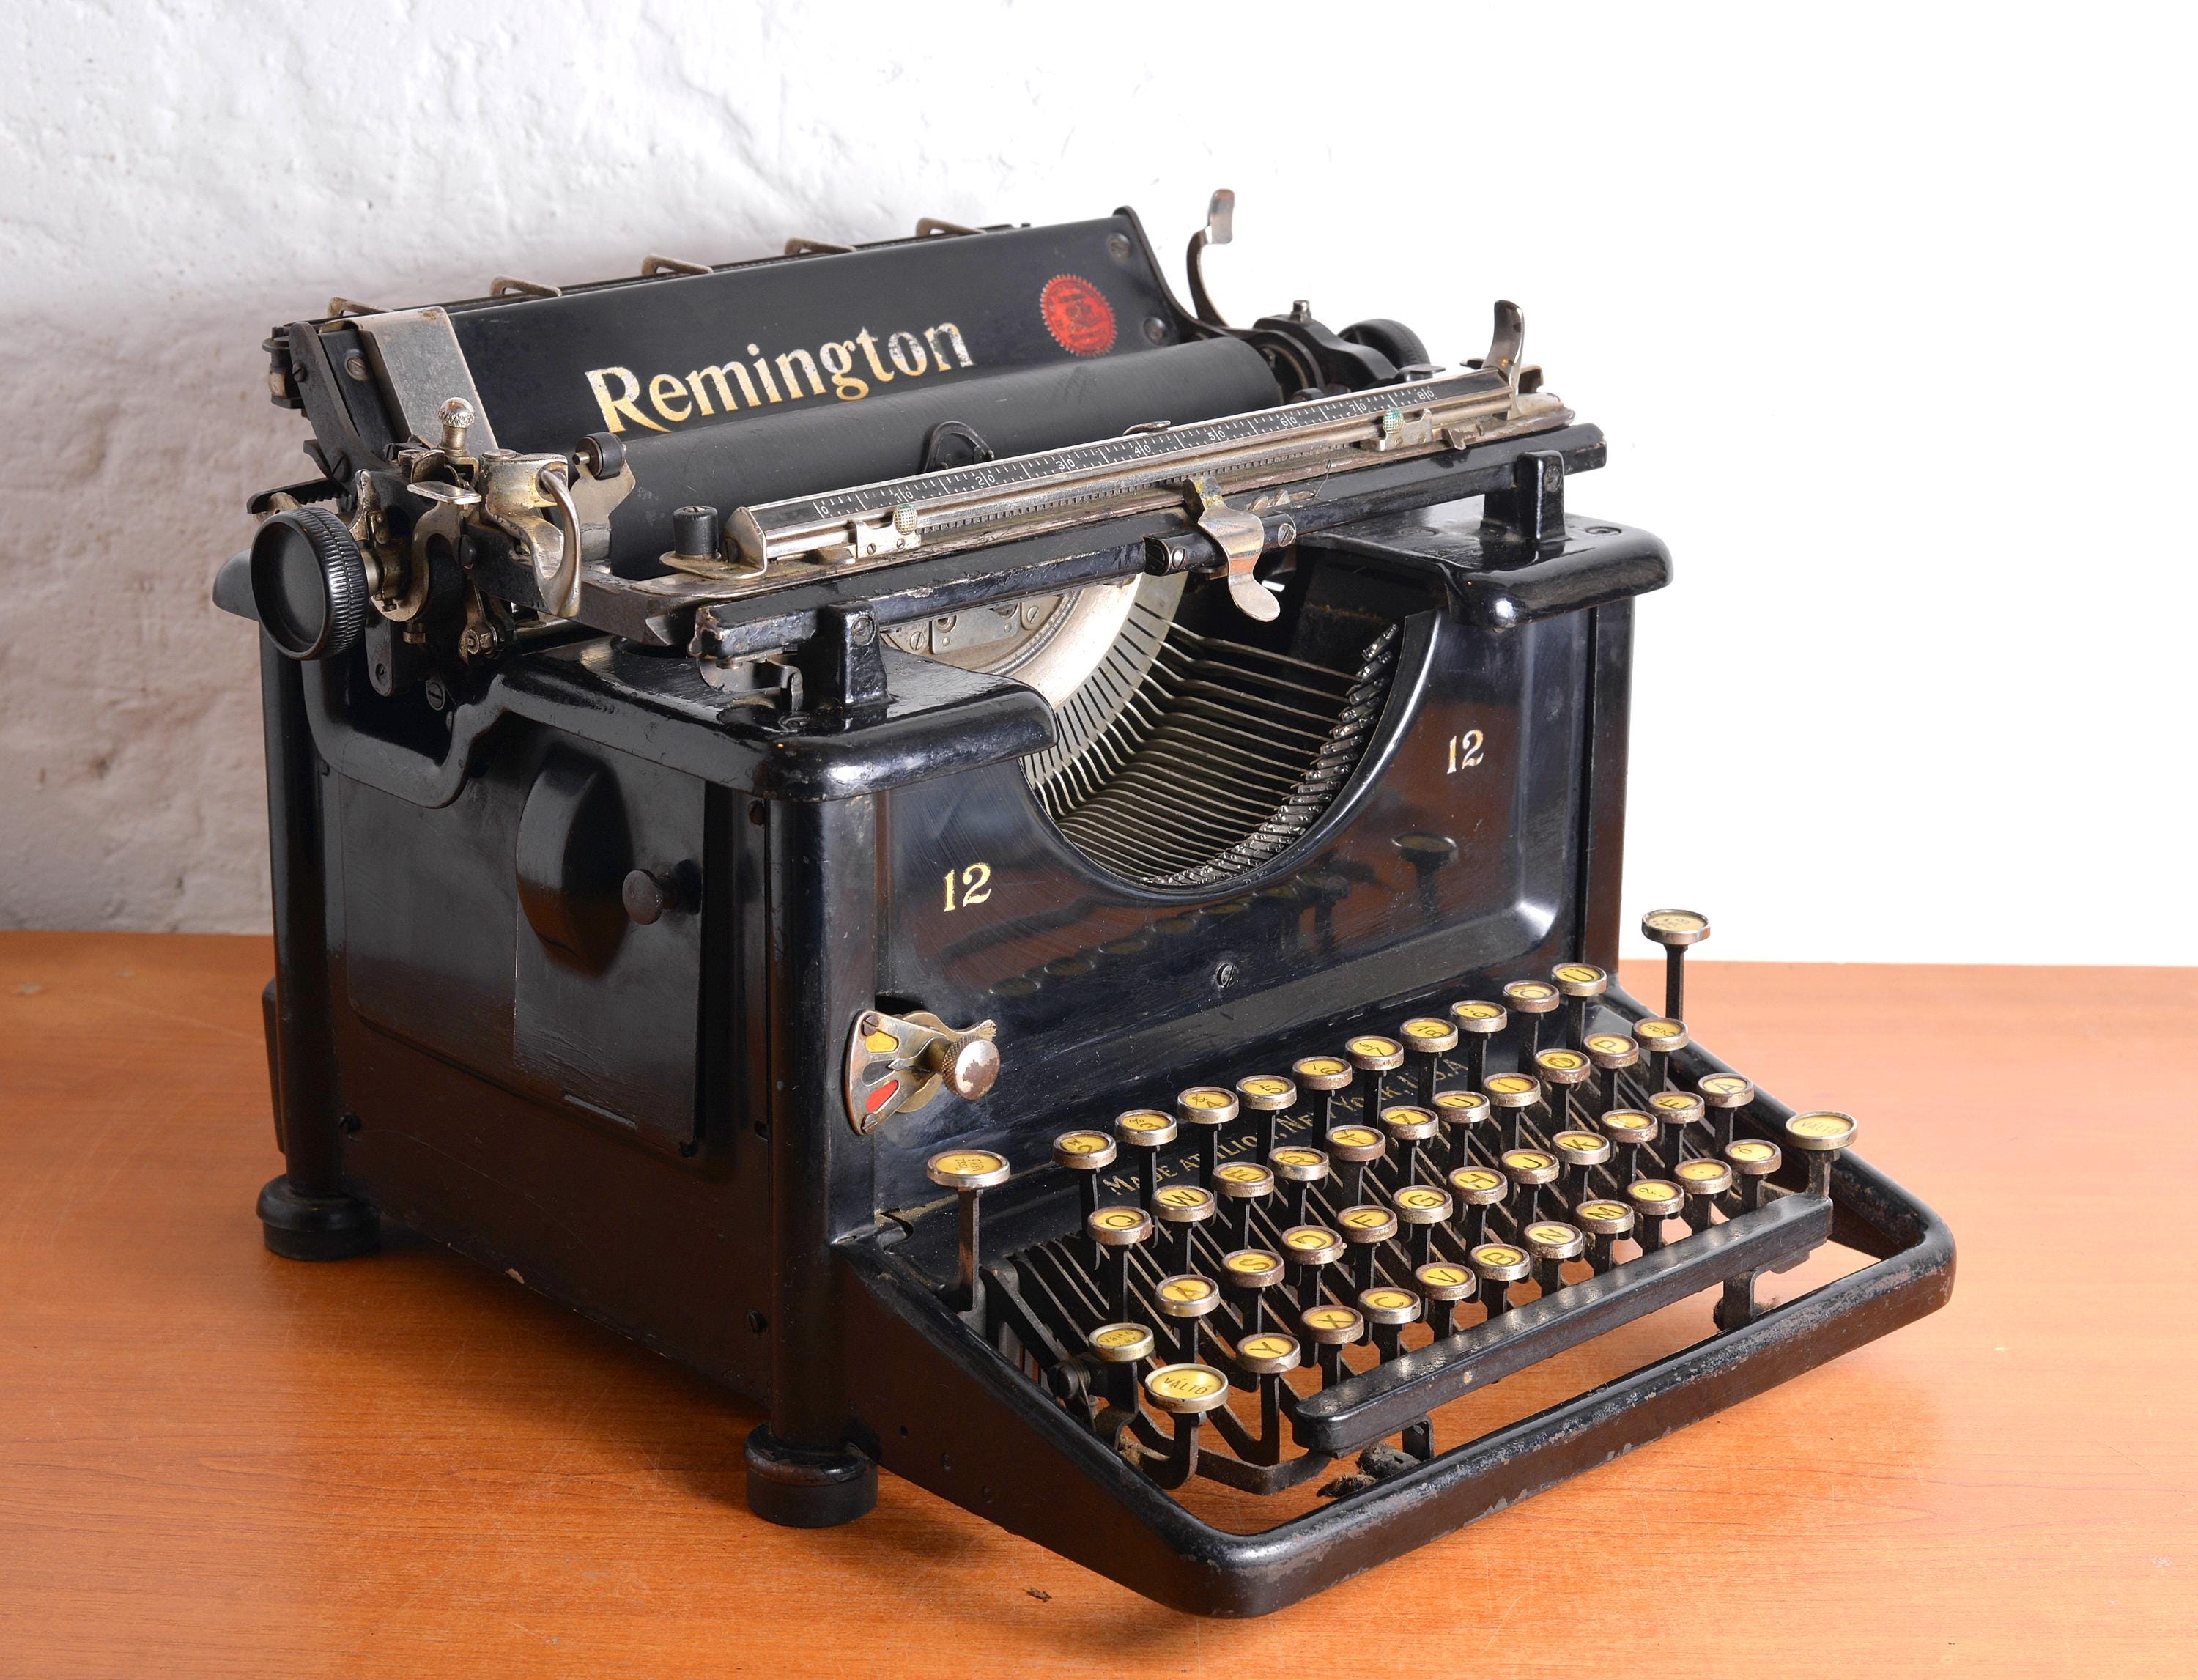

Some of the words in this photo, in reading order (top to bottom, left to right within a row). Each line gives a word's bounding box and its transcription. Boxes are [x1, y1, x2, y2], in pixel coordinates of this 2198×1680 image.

[585, 322, 974, 433] Remington
[1447, 730, 1484, 774] 12
[944, 862, 991, 912] 12
[1562, 967, 1595, 982] Ü
[1366, 1047, 1385, 1057] 7
[1594, 1040, 1617, 1053] P
[1262, 1085, 1283, 1094] 5
[1207, 1100, 1224, 1109] 4
[1443, 1098, 1475, 1108] U
[1390, 1113, 1426, 1125] Z
[1563, 1139, 1598, 1150] K
[1522, 1156, 1542, 1169] J
[1226, 1169, 1262, 1182] E
[1459, 1173, 1495, 1189] H
[1162, 1191, 1199, 1206] W
[1408, 1194, 1443, 1207] G
[1587, 1207, 1624, 1220] M
[1105, 1215, 1141, 1227] Q
[1350, 1214, 1372, 1227] F
[1292, 1235, 1327, 1248] D
[1536, 1228, 1571, 1243] N
[1239, 1258, 1270, 1270] S
[1482, 1252, 1517, 1265] B
[1427, 1270, 1458, 1283] V
[1374, 1296, 1405, 1308] C
[1317, 1314, 1355, 1328] X
[1249, 1342, 1283, 1354] Y
[1164, 1377, 1213, 1395] VÁLTÓ
